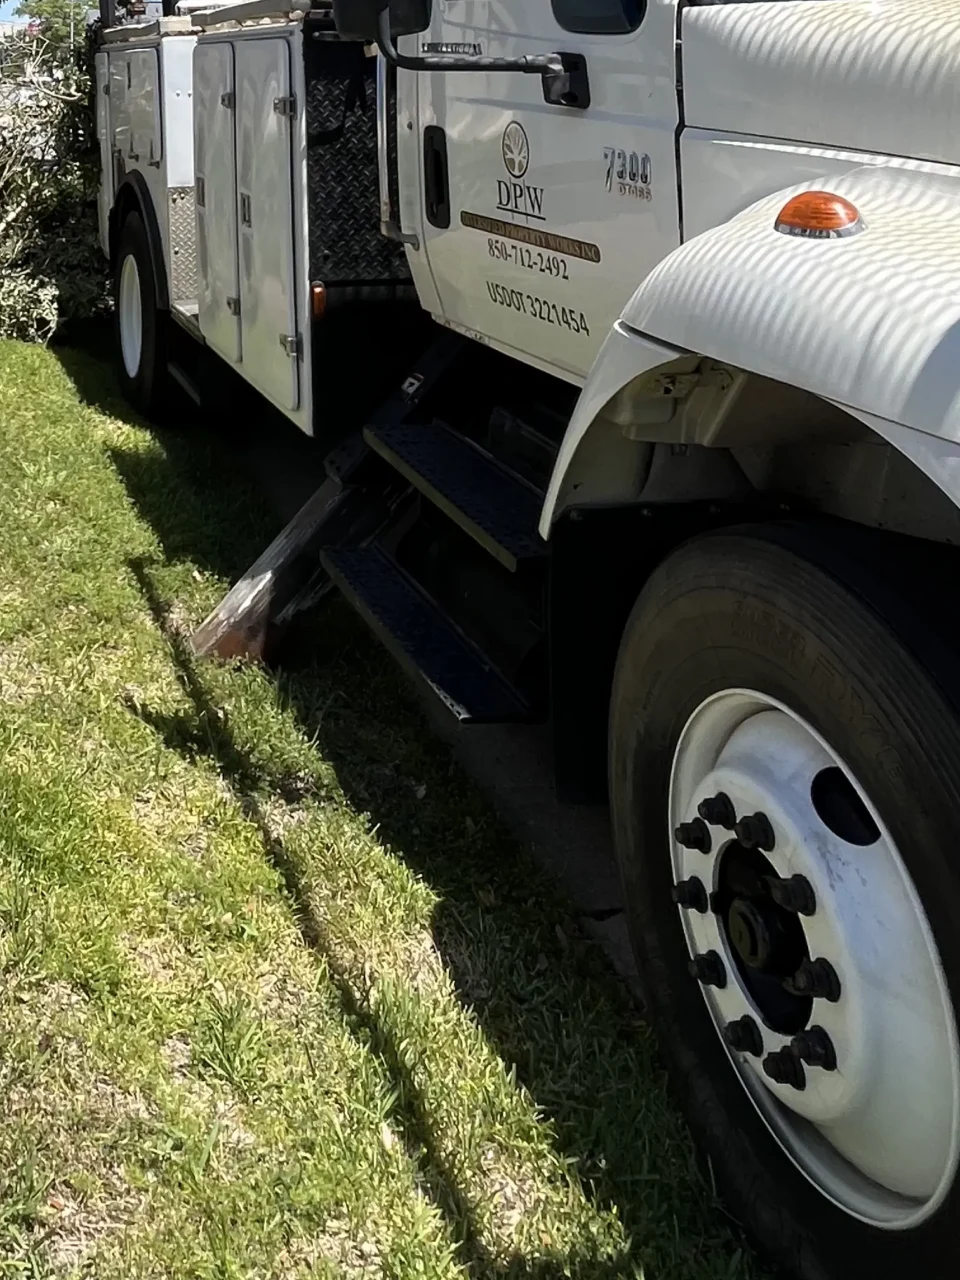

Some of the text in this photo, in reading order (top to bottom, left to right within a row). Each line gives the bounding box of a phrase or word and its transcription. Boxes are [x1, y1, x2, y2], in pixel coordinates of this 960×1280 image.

[602, 146, 652, 193] 7300
[496, 179, 544, 215] DPW
[487, 238, 569, 280] 850-712-2492
[580, 242, 598, 261] INC
[486, 280, 590, 337] USDOT 3221454
